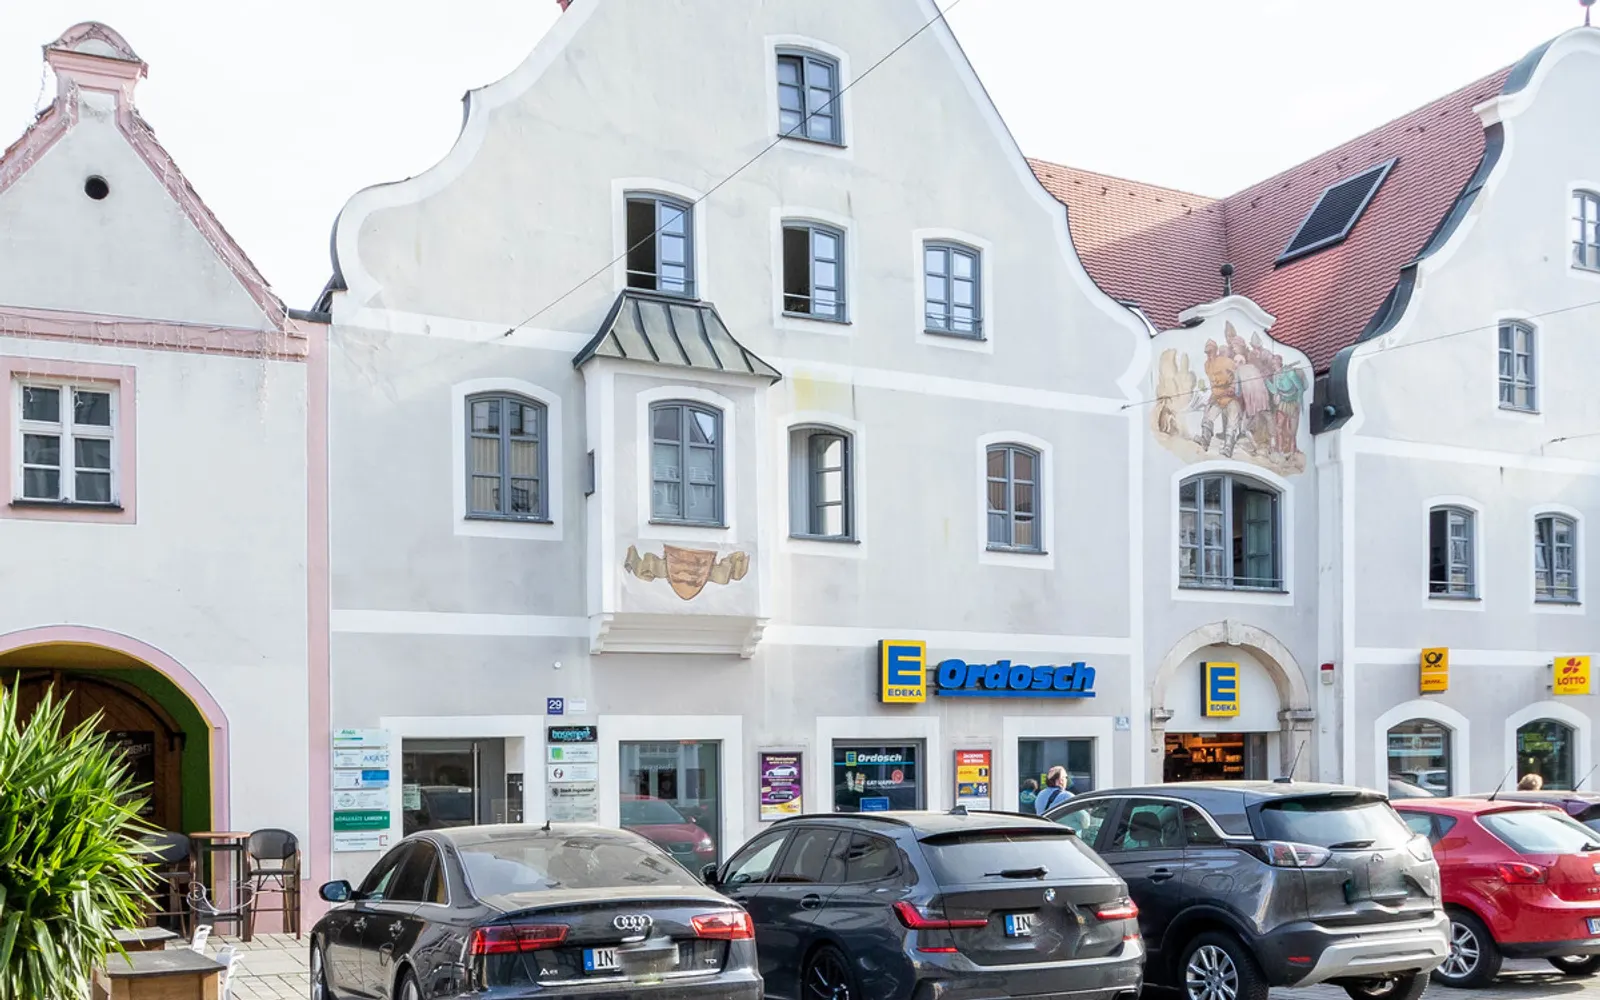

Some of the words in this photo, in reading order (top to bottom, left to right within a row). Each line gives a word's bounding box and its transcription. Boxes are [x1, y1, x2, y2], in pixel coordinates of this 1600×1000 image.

[888, 645, 921, 686] E
[937, 658, 1096, 690] Ordosch
[1210, 667, 1236, 702] E
[1557, 676, 1586, 686] LOTTO
[887, 689, 922, 697] EDEKA
[549, 699, 562, 710] 29
[1210, 703, 1237, 712] EDEKA
[857, 753, 902, 763] Ordosch
[978, 785, 988, 793] 85
[1015, 916, 1031, 931] IN
[597, 950, 614, 967] IN
[539, 967, 559, 976] A6
